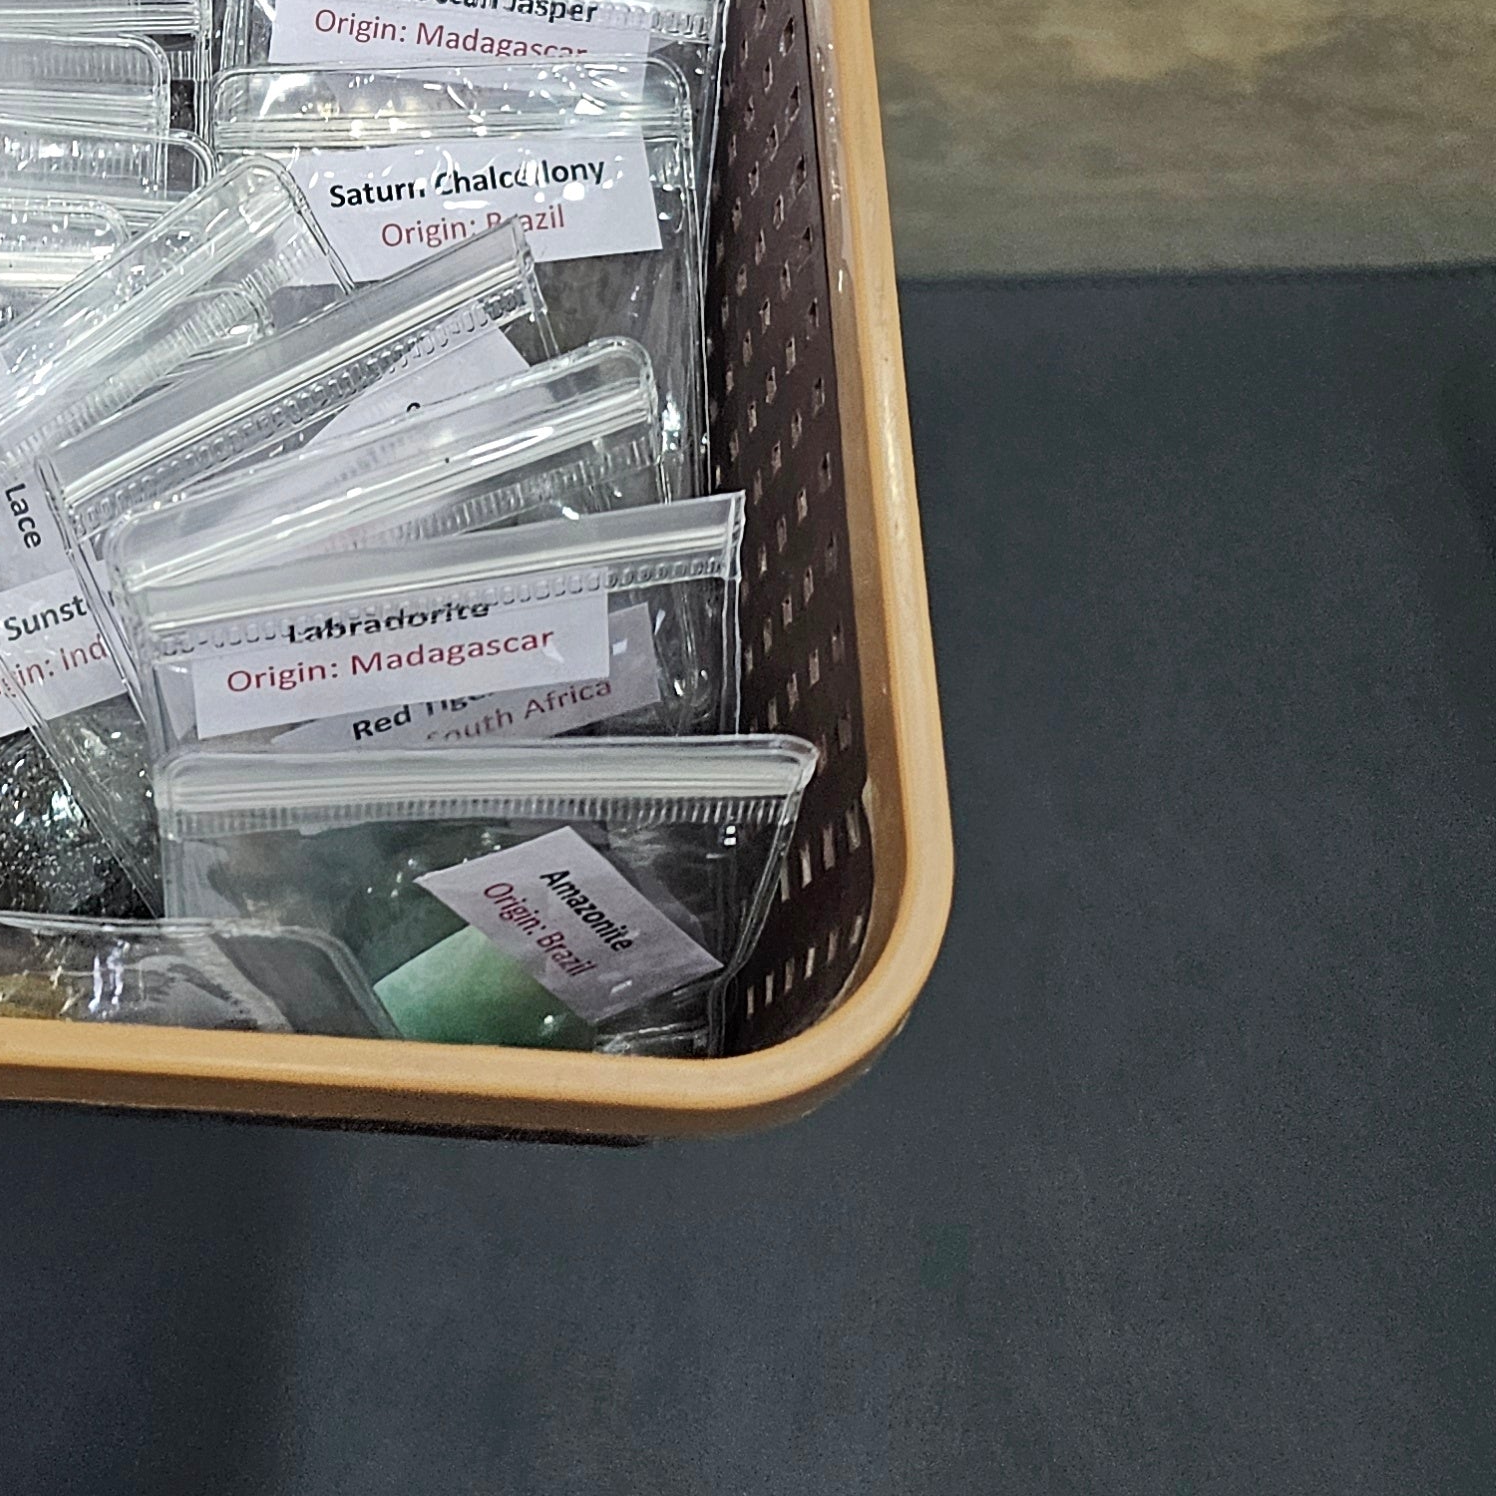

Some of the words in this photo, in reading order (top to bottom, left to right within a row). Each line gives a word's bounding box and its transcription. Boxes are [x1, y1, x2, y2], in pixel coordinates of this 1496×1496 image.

[314, 8, 408, 43] Origin:
[381, 216, 477, 248] Origin:
[486, 203, 566, 233] Bazil
[5, 482, 43, 549] Lace
[3, 595, 88, 642] Sunst
[287, 601, 492, 644] Labradorite
[60, 633, 108, 671] Ind
[226, 661, 339, 693] Origin:
[350, 628, 556, 677] Madagascar
[523, 679, 613, 720] Africa
[352, 704, 412, 741] Red
[483, 882, 546, 936] Origin:
[536, 930, 597, 977] Brazil
[539, 870, 635, 953] Amazonite
